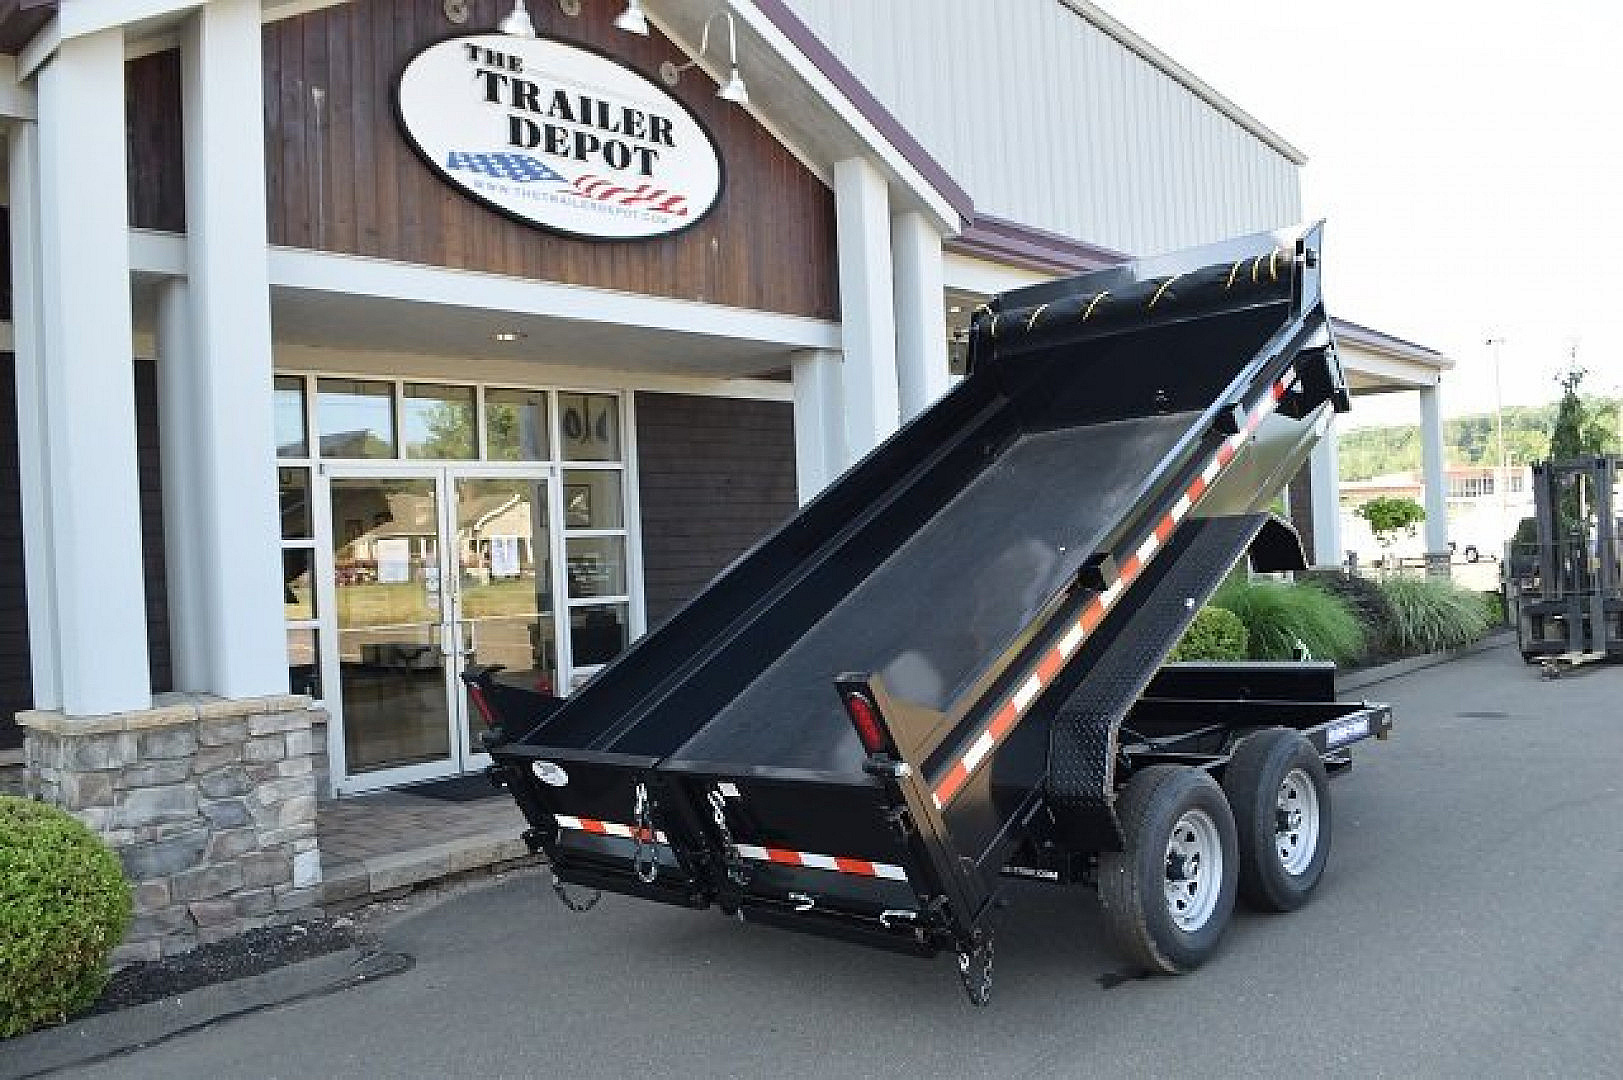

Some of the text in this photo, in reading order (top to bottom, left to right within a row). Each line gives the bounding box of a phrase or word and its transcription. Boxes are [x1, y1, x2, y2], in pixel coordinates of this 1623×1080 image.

[463, 43, 524, 73] THE
[476, 68, 676, 147] TRAILER
[508, 114, 660, 176] DEPOT
